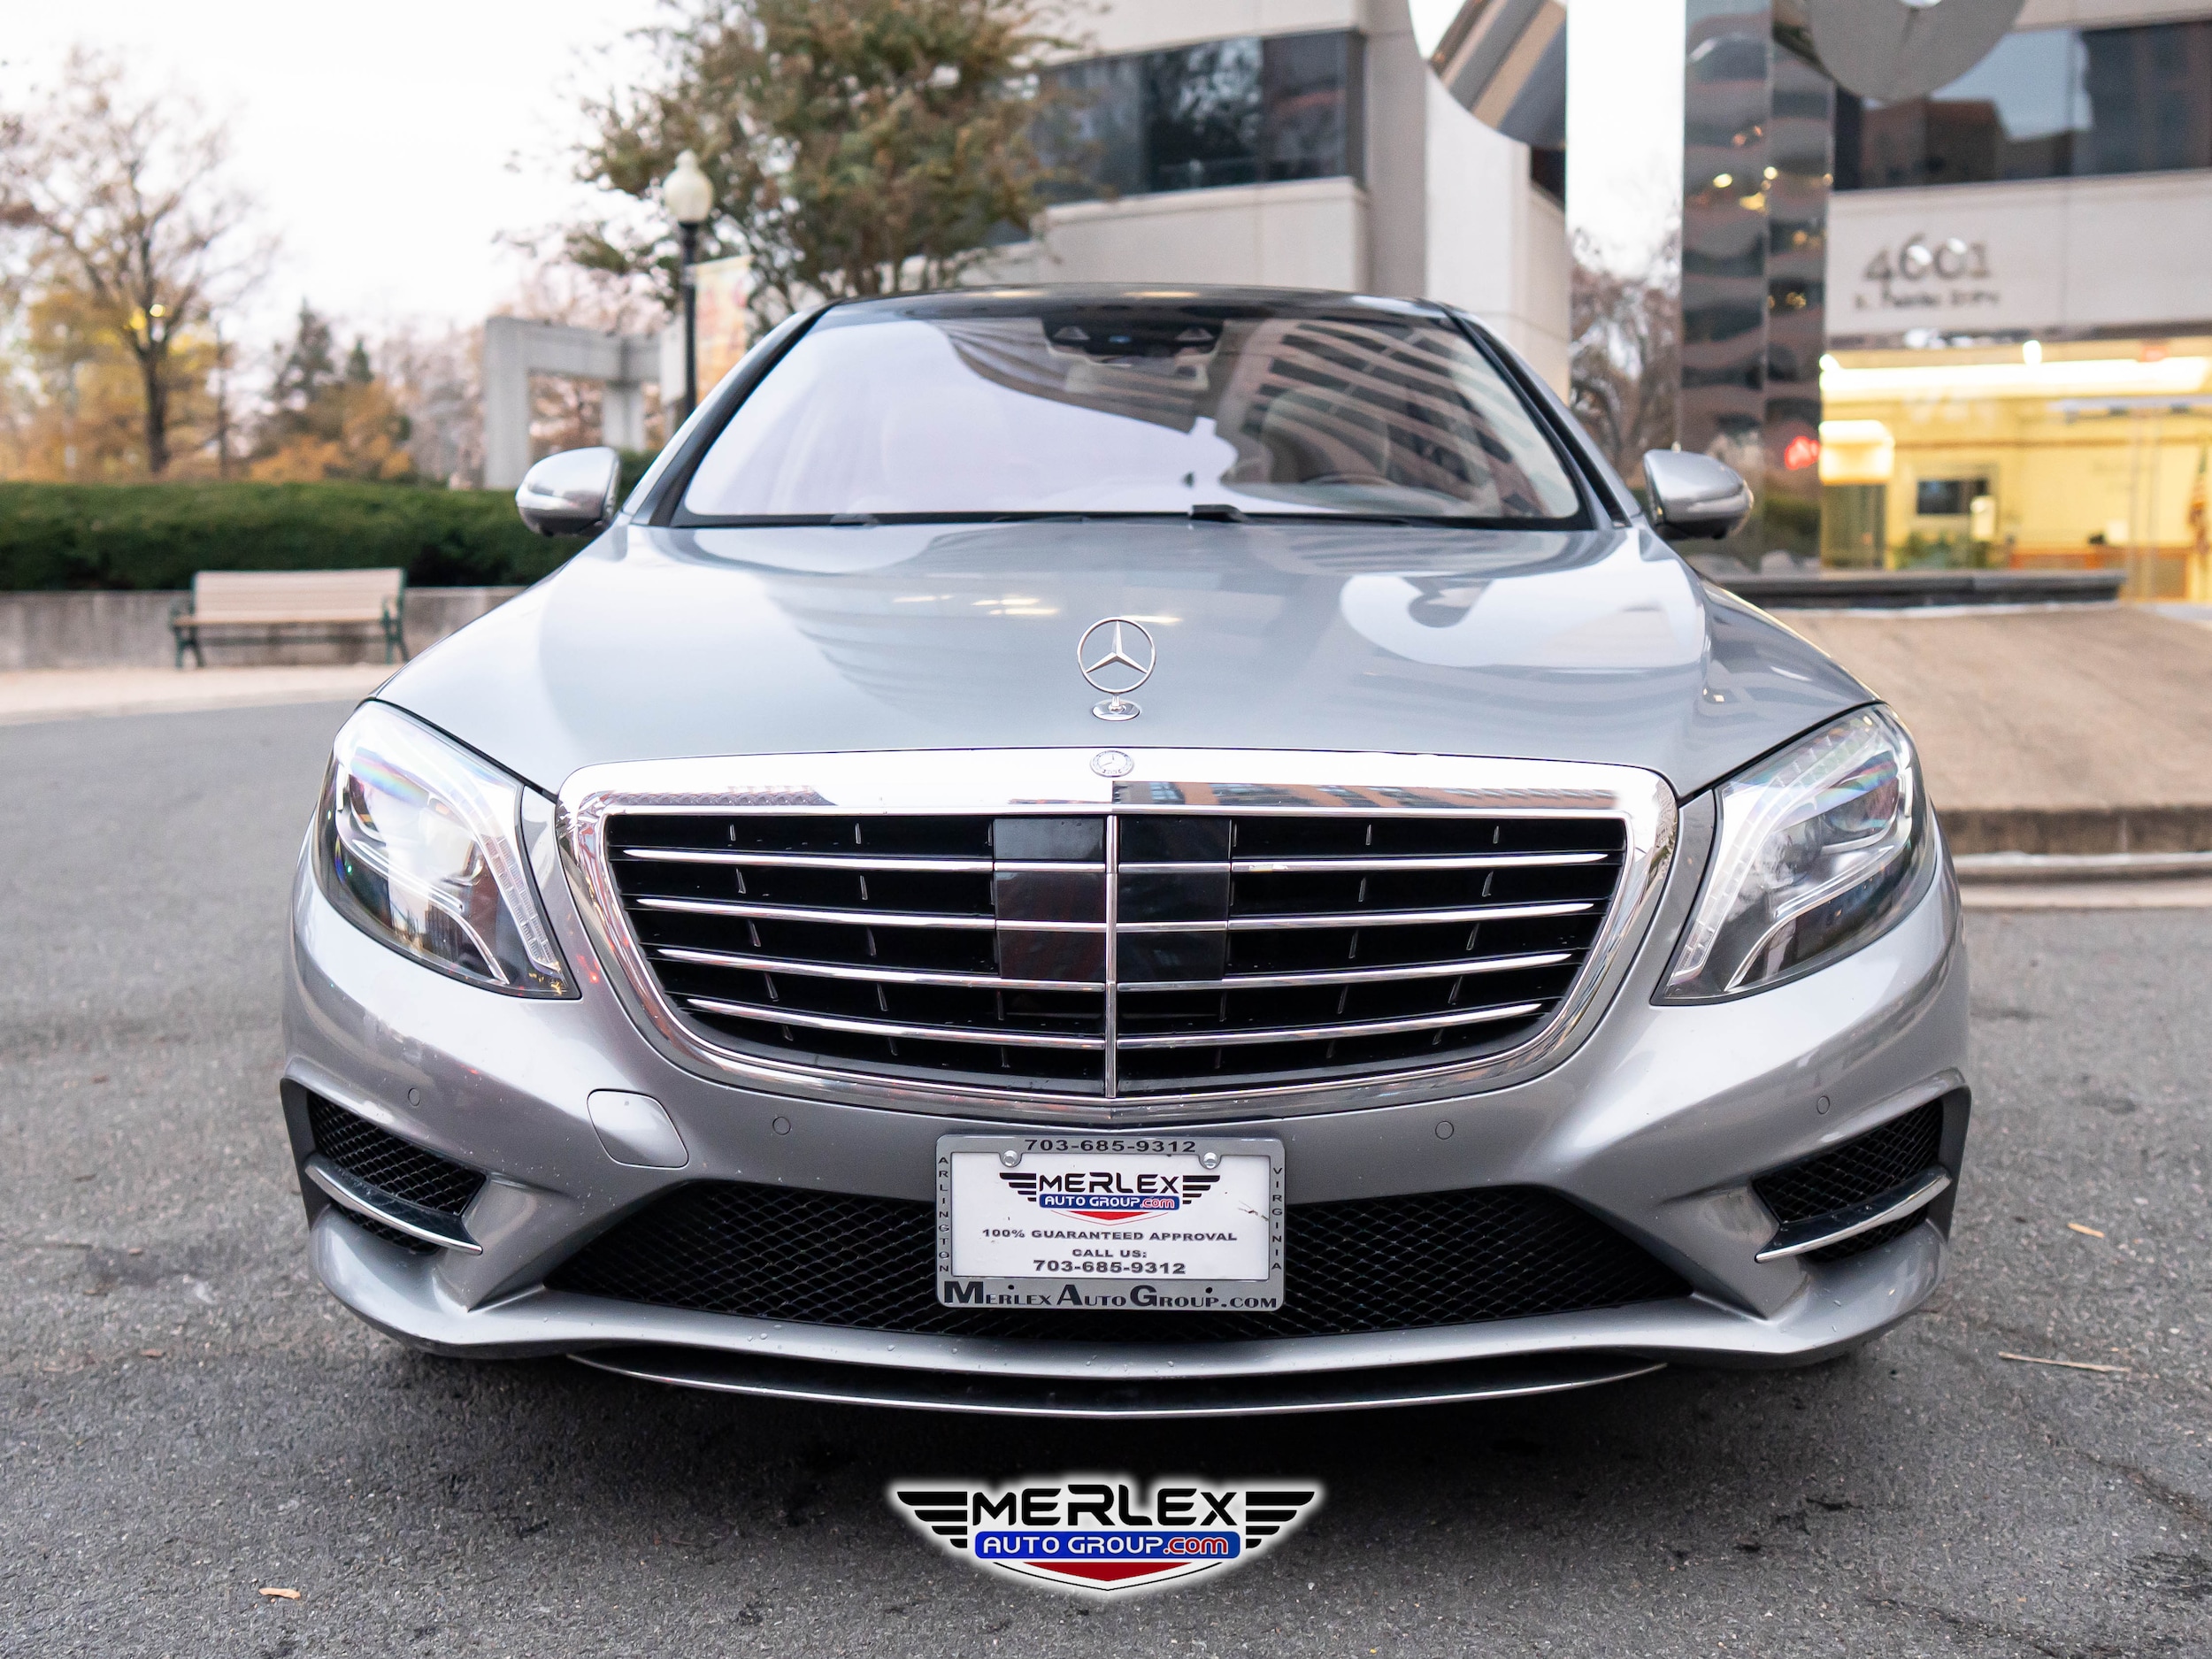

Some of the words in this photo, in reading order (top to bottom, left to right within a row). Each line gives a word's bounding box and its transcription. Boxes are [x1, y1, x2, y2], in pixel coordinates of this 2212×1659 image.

[1864, 232, 1991, 288] 4601
[1025, 1139, 1195, 1153] 703-685-9312
[1039, 1171, 1179, 1194] MERLEX
[1044, 1196, 1085, 1207] AUTO
[1089, 1197, 1175, 1209] GROUP.com
[938, 1156, 949, 1272] ARLINGTON
[1271, 1167, 1283, 1271] VIRGINIA
[982, 1229, 1025, 1238] 100%
[1031, 1230, 1144, 1240] GUARANTEED
[1149, 1233, 1238, 1241] APPROVAL
[1071, 1248, 1113, 1258] CALL
[1120, 1249, 1148, 1258] US:
[1033, 1260, 1187, 1275] 703-685-9312
